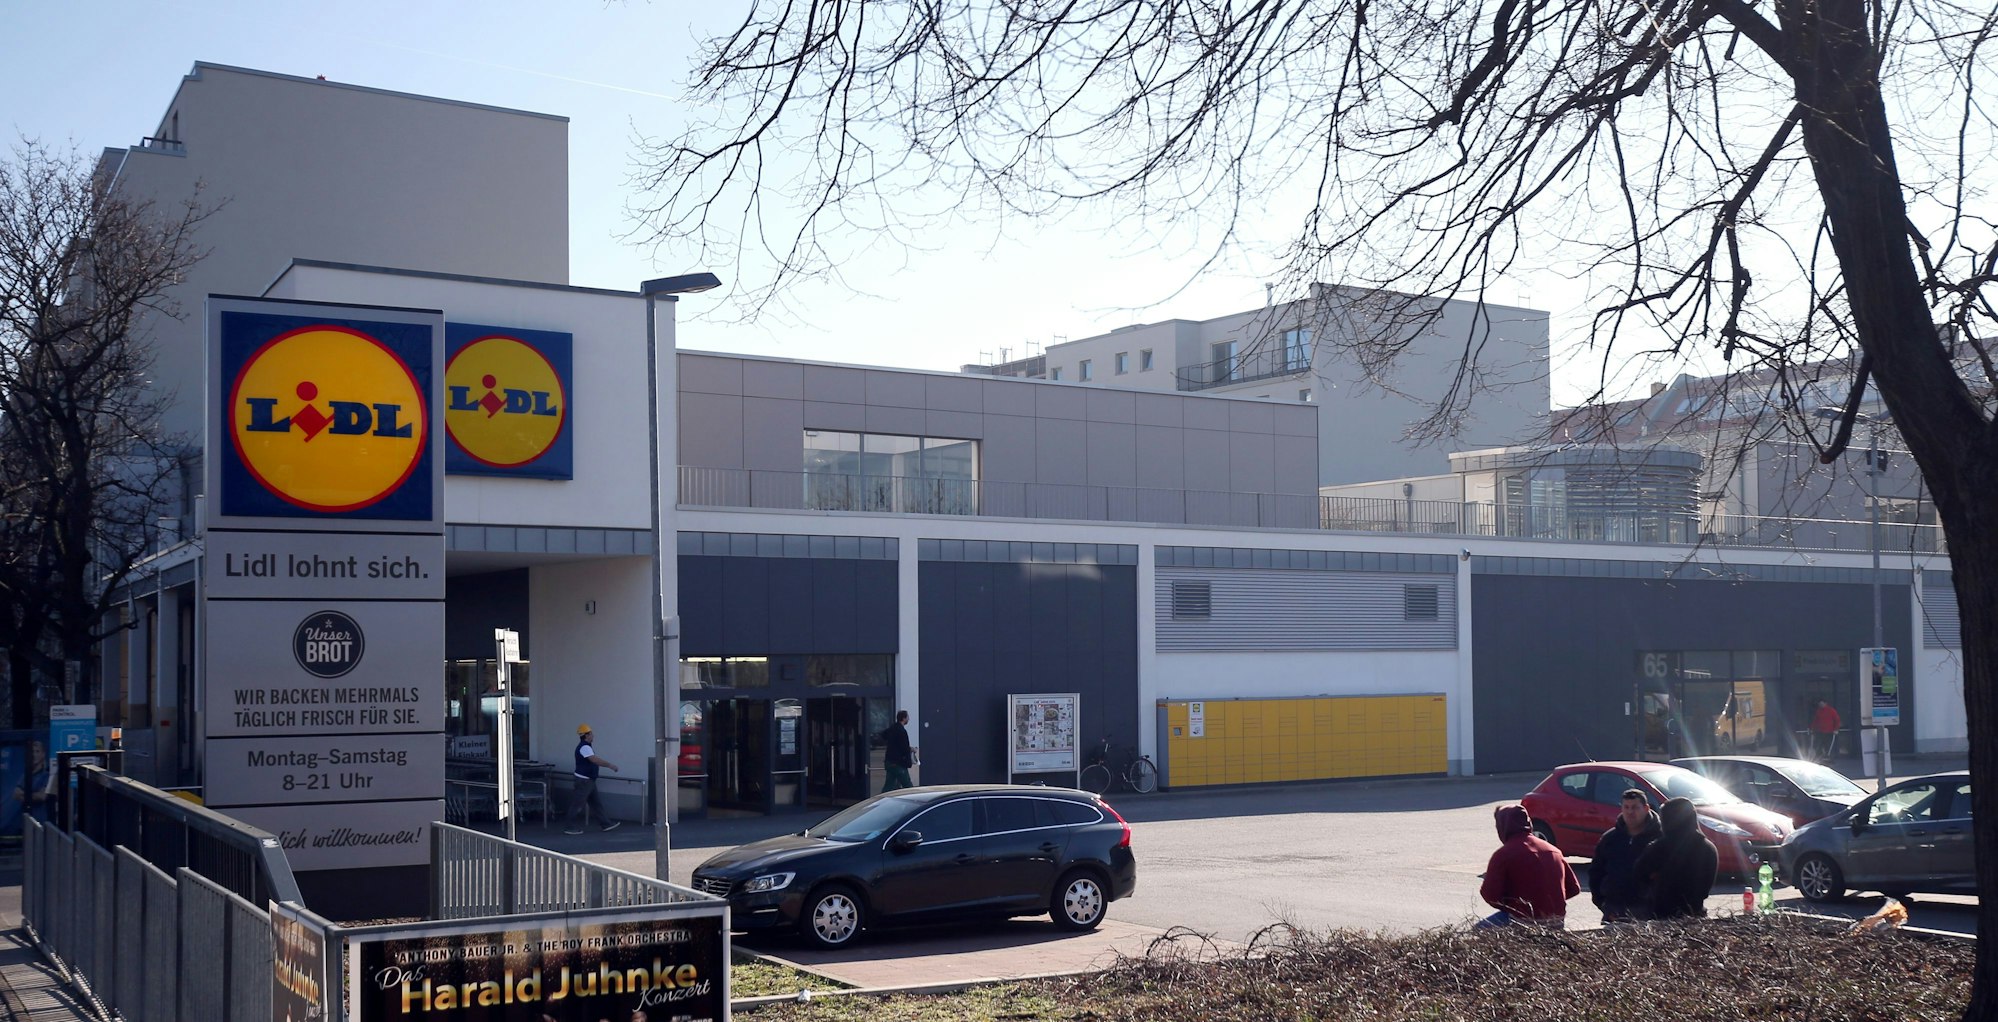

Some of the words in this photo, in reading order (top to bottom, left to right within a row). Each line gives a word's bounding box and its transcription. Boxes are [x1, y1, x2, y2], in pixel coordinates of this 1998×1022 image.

[225, 552, 277, 578] Lidl
[288, 554, 358, 579] lohnt
[367, 555, 429, 579] sich.
[305, 627, 353, 641] Unser
[306, 641, 353, 663] BROT
[1643, 653, 1668, 678] 65
[234, 689, 266, 705] WIR
[270, 688, 331, 705] BACKEN
[335, 687, 420, 704] MEHRMALS
[234, 708, 297, 728] TÄGLICH
[301, 709, 354, 726] FRISCH
[360, 706, 389, 725] FÜR
[393, 708, 421, 725] SIE.
[340, 773, 374, 789] Uhr
[312, 826, 422, 848] willkommen!
[400, 948, 456, 964] ANTHONY
[459, 945, 498, 958] BAUER
[501, 944, 518, 955] JR.
[522, 943, 532, 952] &
[537, 940, 558, 952] THE
[588, 935, 624, 948] FRANK
[627, 930, 692, 945] ORCHESTRA
[374, 964, 427, 991] Das
[401, 966, 542, 1014] Harald
[552, 956, 698, 1001] Juhnke
[632, 979, 711, 1013] Konzert
